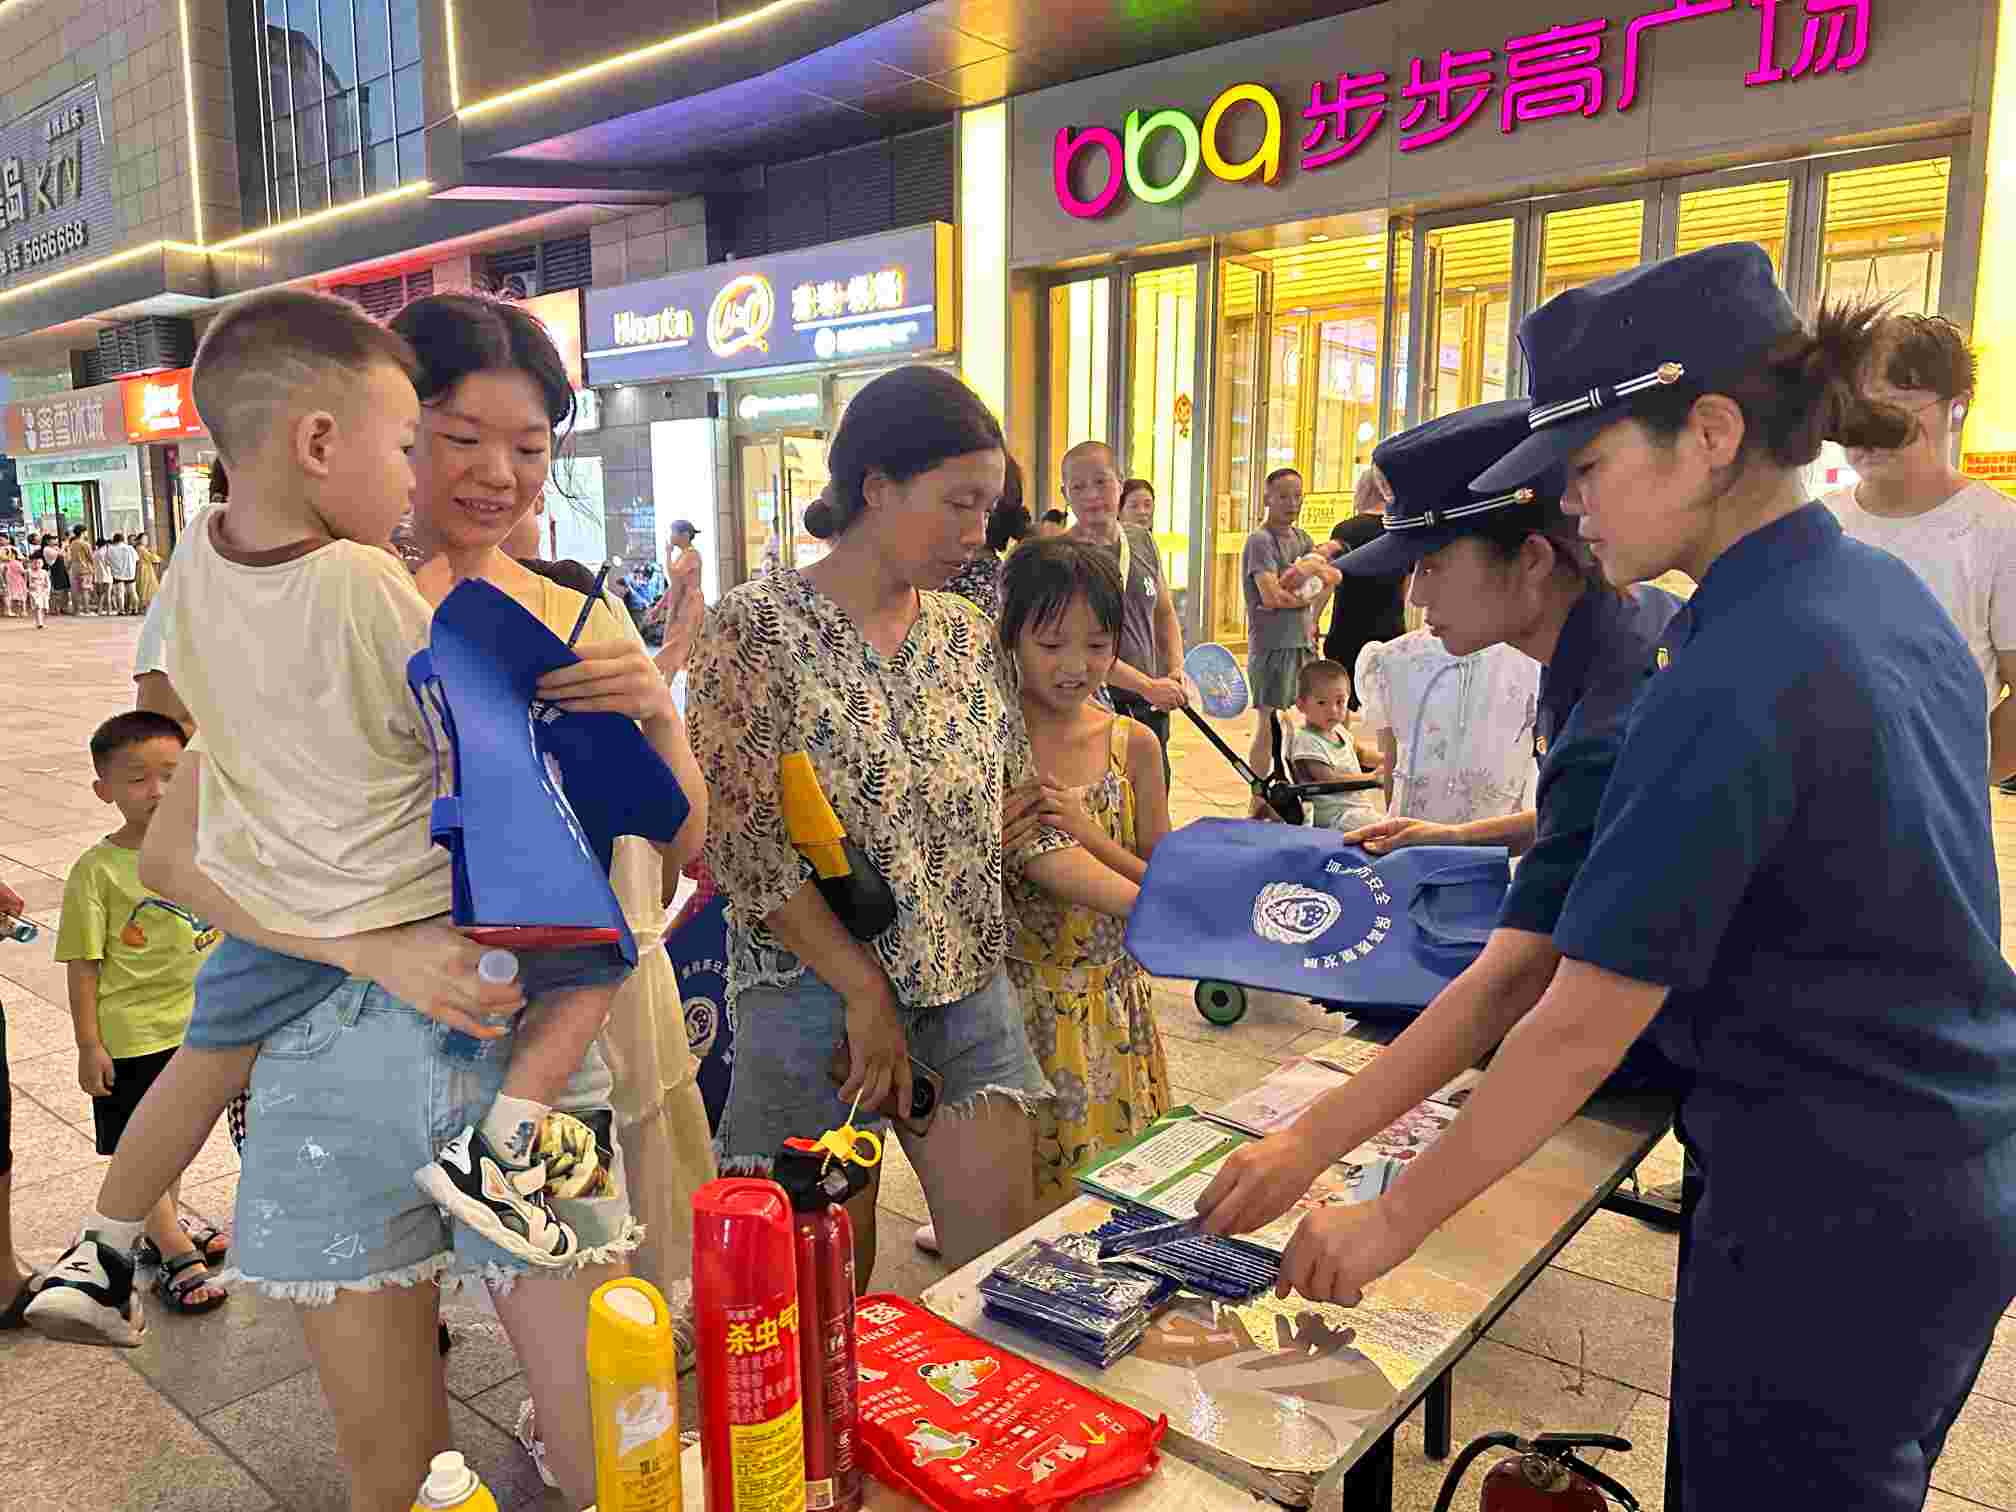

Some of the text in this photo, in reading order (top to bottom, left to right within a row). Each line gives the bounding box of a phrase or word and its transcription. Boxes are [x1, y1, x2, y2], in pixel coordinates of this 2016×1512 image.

[1301, 0, 1872, 170] 步步高广场
